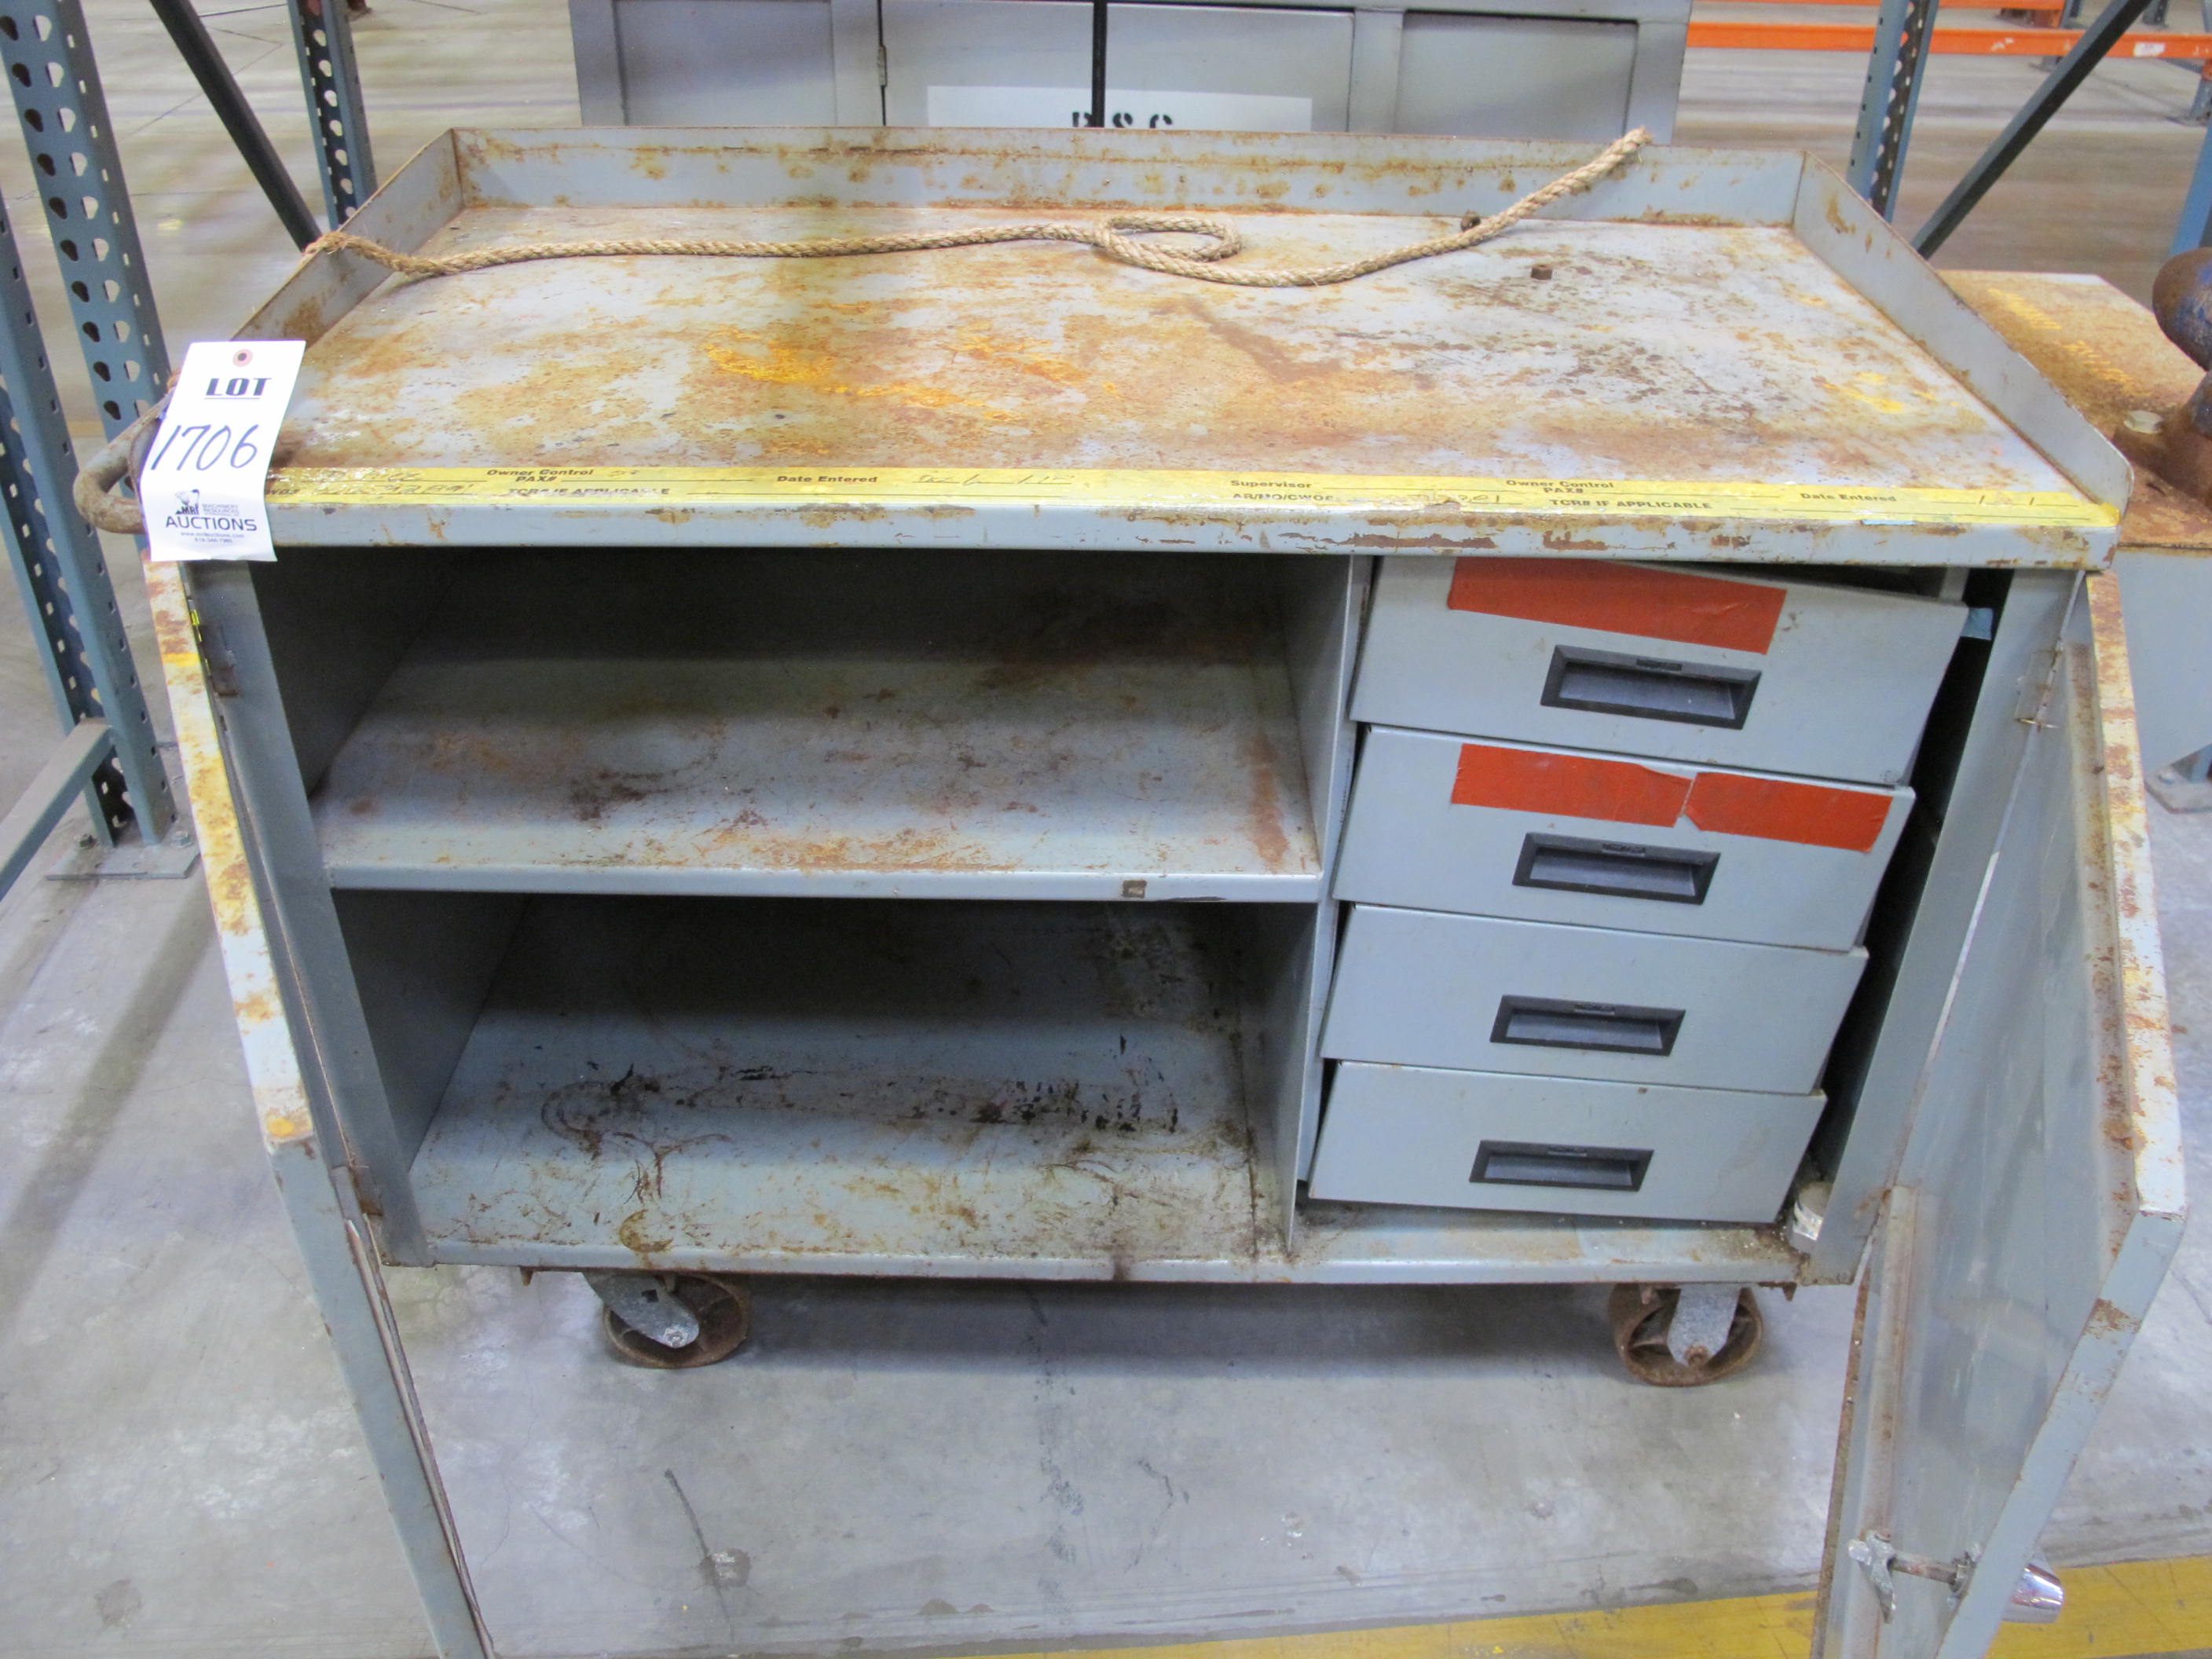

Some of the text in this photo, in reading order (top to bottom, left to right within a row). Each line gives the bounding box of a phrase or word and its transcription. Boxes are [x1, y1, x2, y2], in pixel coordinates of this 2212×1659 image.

[205, 377, 272, 396] LOT
[151, 423, 259, 471] 1706
[777, 474, 878, 483] Date Entered
[1231, 480, 1313, 489] Supervisor
[1839, 493, 1897, 503] Entered
[1617, 500, 1711, 509] APPLICABLE
[165, 515, 258, 532] AUCTIONS
